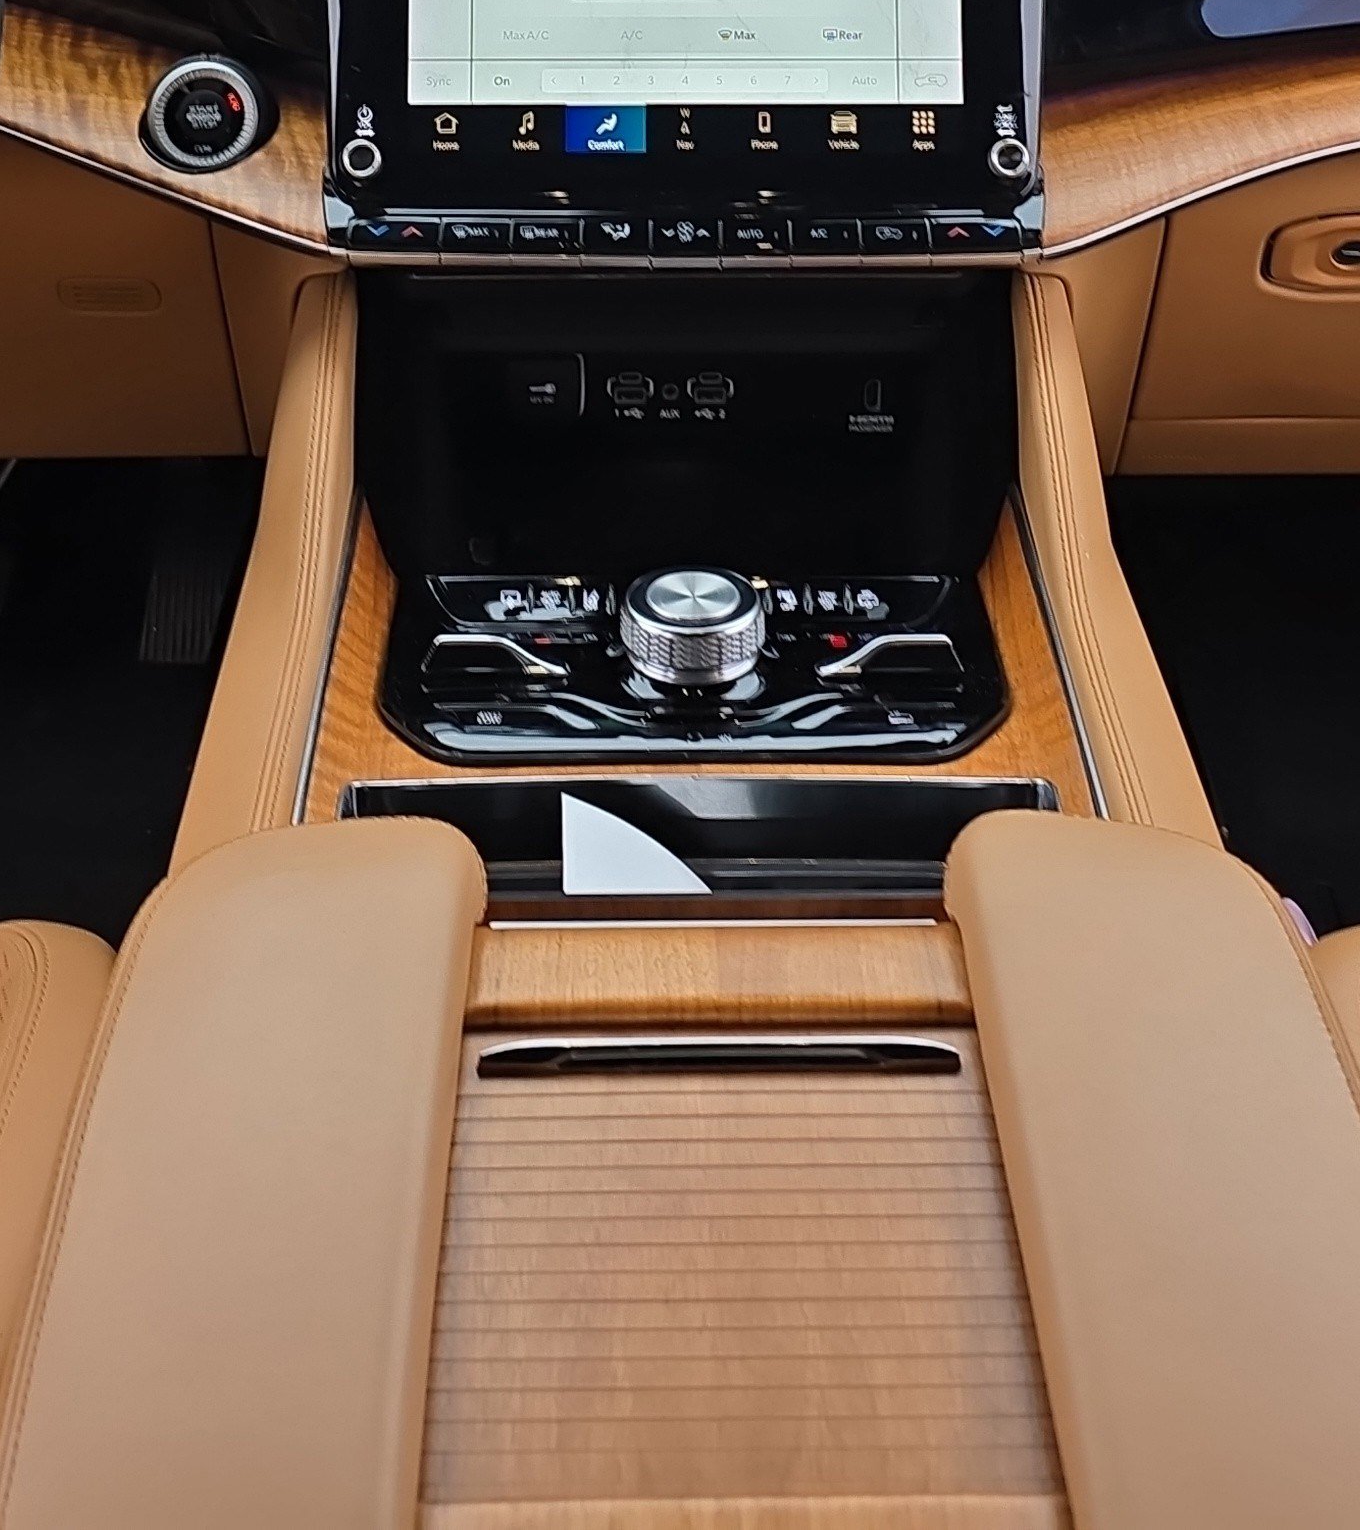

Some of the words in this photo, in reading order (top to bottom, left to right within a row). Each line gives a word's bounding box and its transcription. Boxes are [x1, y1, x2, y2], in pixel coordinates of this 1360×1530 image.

[502, 30, 525, 41] Max
[526, 29, 550, 41] A/C
[620, 29, 644, 41] A/C
[734, 30, 756, 40] Max
[839, 29, 863, 40] Rear
[426, 75, 452, 88] Sync
[494, 75, 511, 86] On
[613, 75, 621, 85] 2
[647, 75, 655, 85] 3
[681, 75, 689, 85] 4
[716, 75, 723, 85] 5
[750, 75, 758, 85] 6
[784, 75, 791, 85] 7
[852, 75, 878, 86] Auto
[432, 139, 460, 152] Home
[512, 139, 540, 152] Media
[587, 139, 625, 152] Comfort
[676, 139, 695, 151] Nav
[751, 139, 779, 151] Phone
[828, 138, 860, 151] Vehicle
[737, 229, 764, 240] AUTO
[659, 408, 680, 419] AUX
